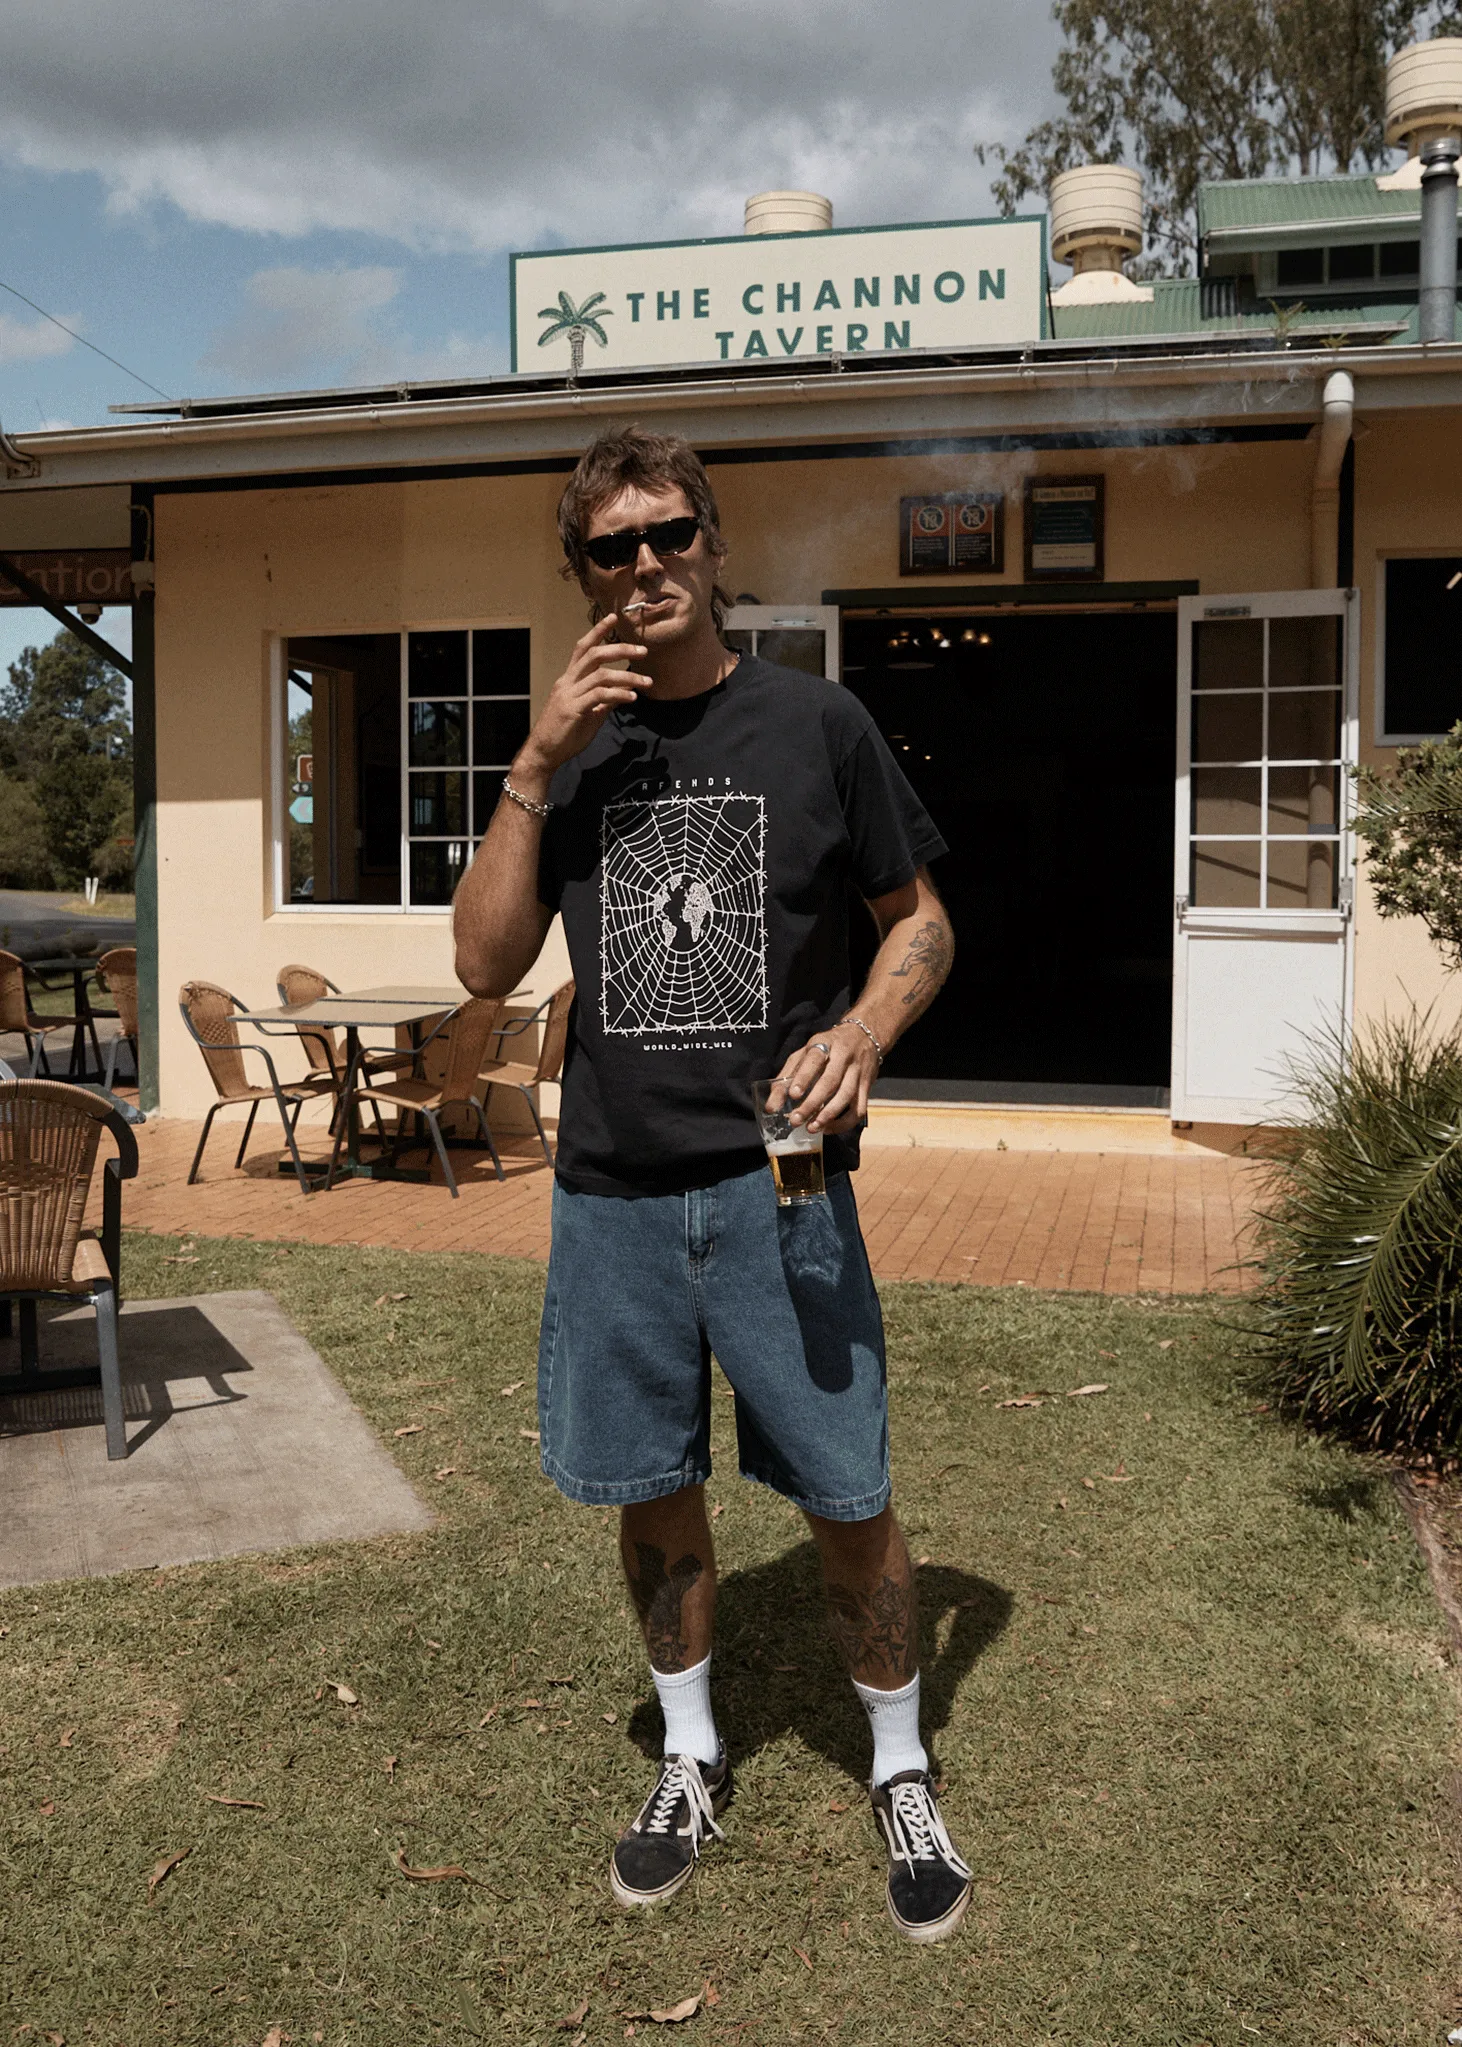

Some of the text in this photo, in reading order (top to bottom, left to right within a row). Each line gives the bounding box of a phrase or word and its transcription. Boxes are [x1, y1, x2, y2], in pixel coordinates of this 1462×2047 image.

[626, 268, 1006, 323] THE CHANNON
[715, 320, 911, 360] TAVERN
[641, 776, 732, 792] AFENDS
[642, 1041, 734, 1052] WORLD_WIDE_WEB
